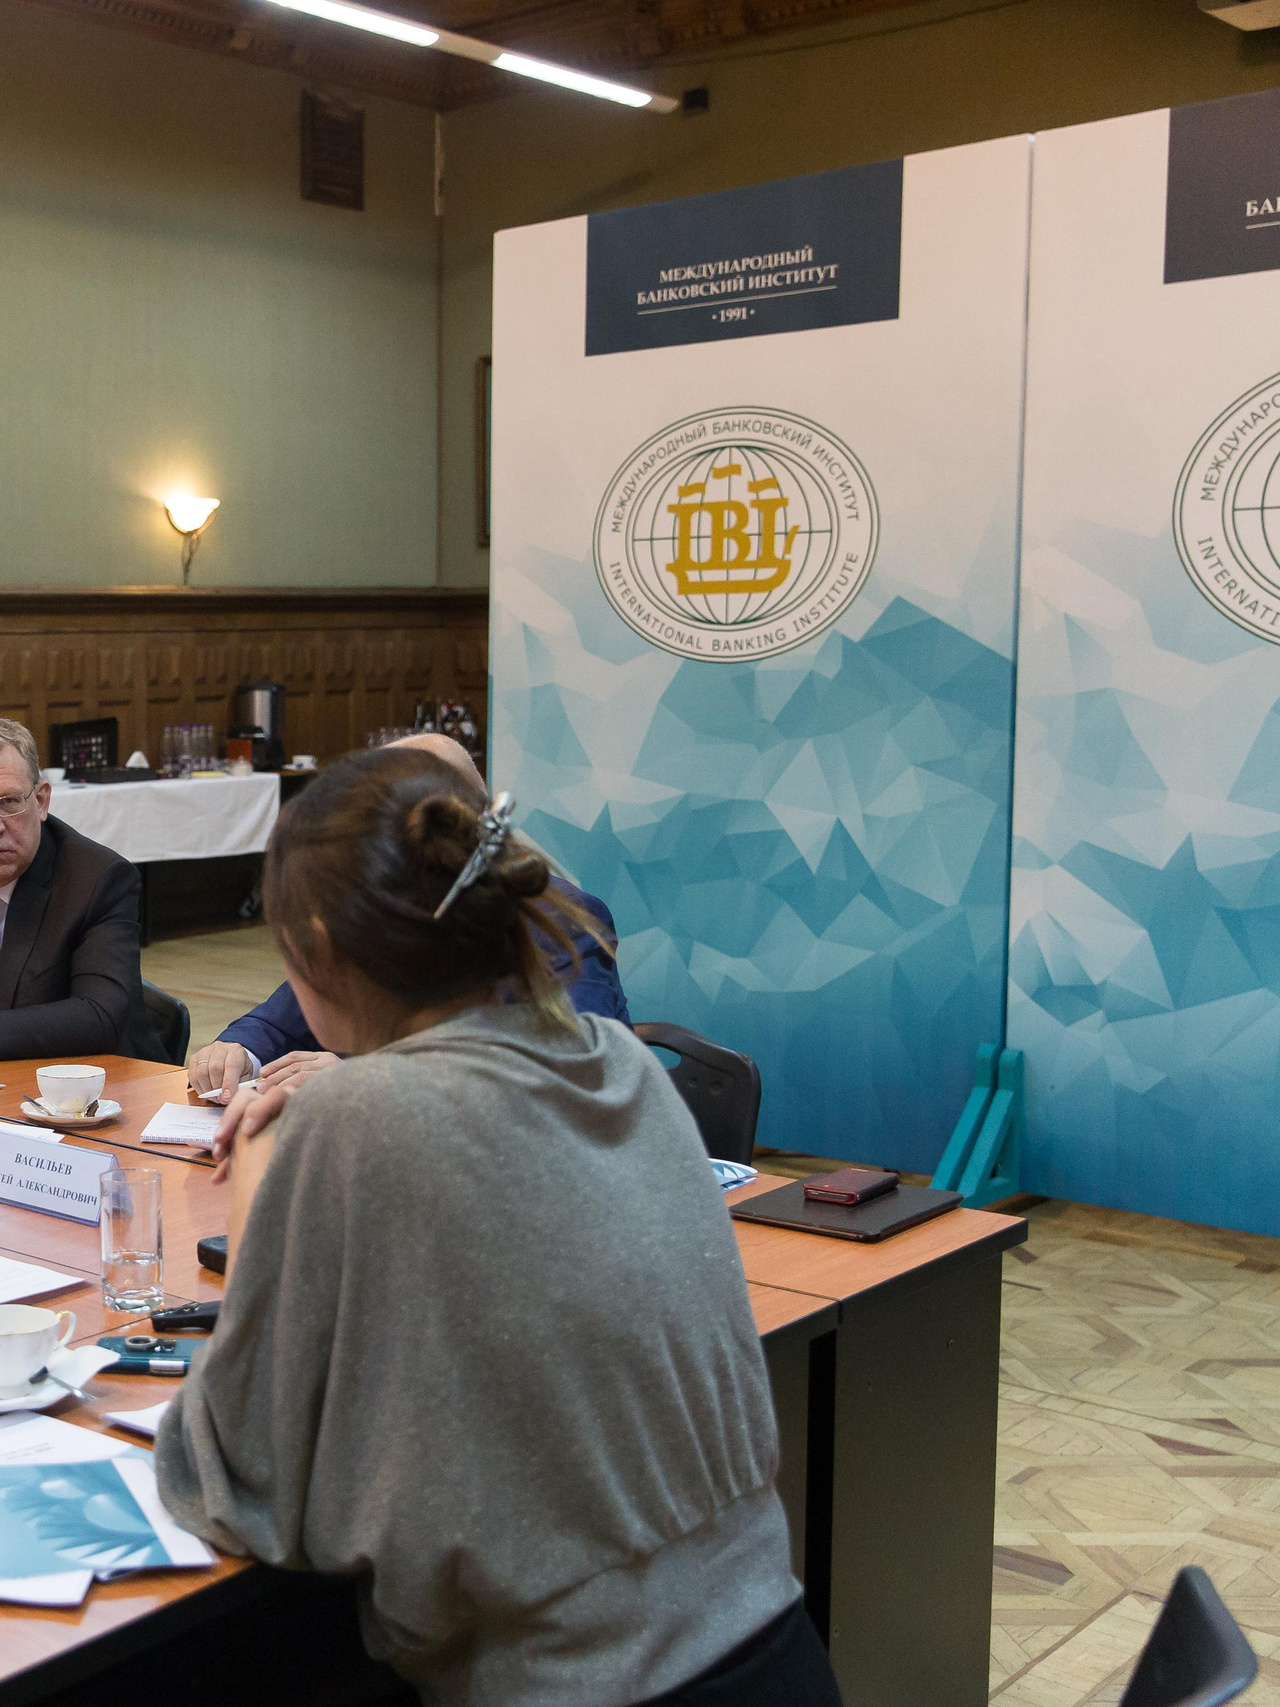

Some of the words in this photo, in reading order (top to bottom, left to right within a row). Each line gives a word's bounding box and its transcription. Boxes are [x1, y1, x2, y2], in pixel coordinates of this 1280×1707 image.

[637, 275, 745, 305] БАНКОВСКИЙ
[748, 263, 839, 289] ИНСТИТУТ
[659, 245, 813, 284] МЕЖДУНАРОДНЫЙ
[611, 423, 707, 533] МЕЖДУНАРОДНЫЙ
[712, 419, 813, 450] БАНКОВСКИЙ
[812, 444, 859, 521] ИНСТИТУТ
[610, 561, 703, 650] INTERNATIONAL
[712, 628, 787, 651] BANKING
[792, 552, 858, 632] INSTITUTE
[15, 1153, 73, 1175] ВАСИЛЬЕВ
[16, 1178, 98, 1206] АЛЕКСАНДРОВИЧ
